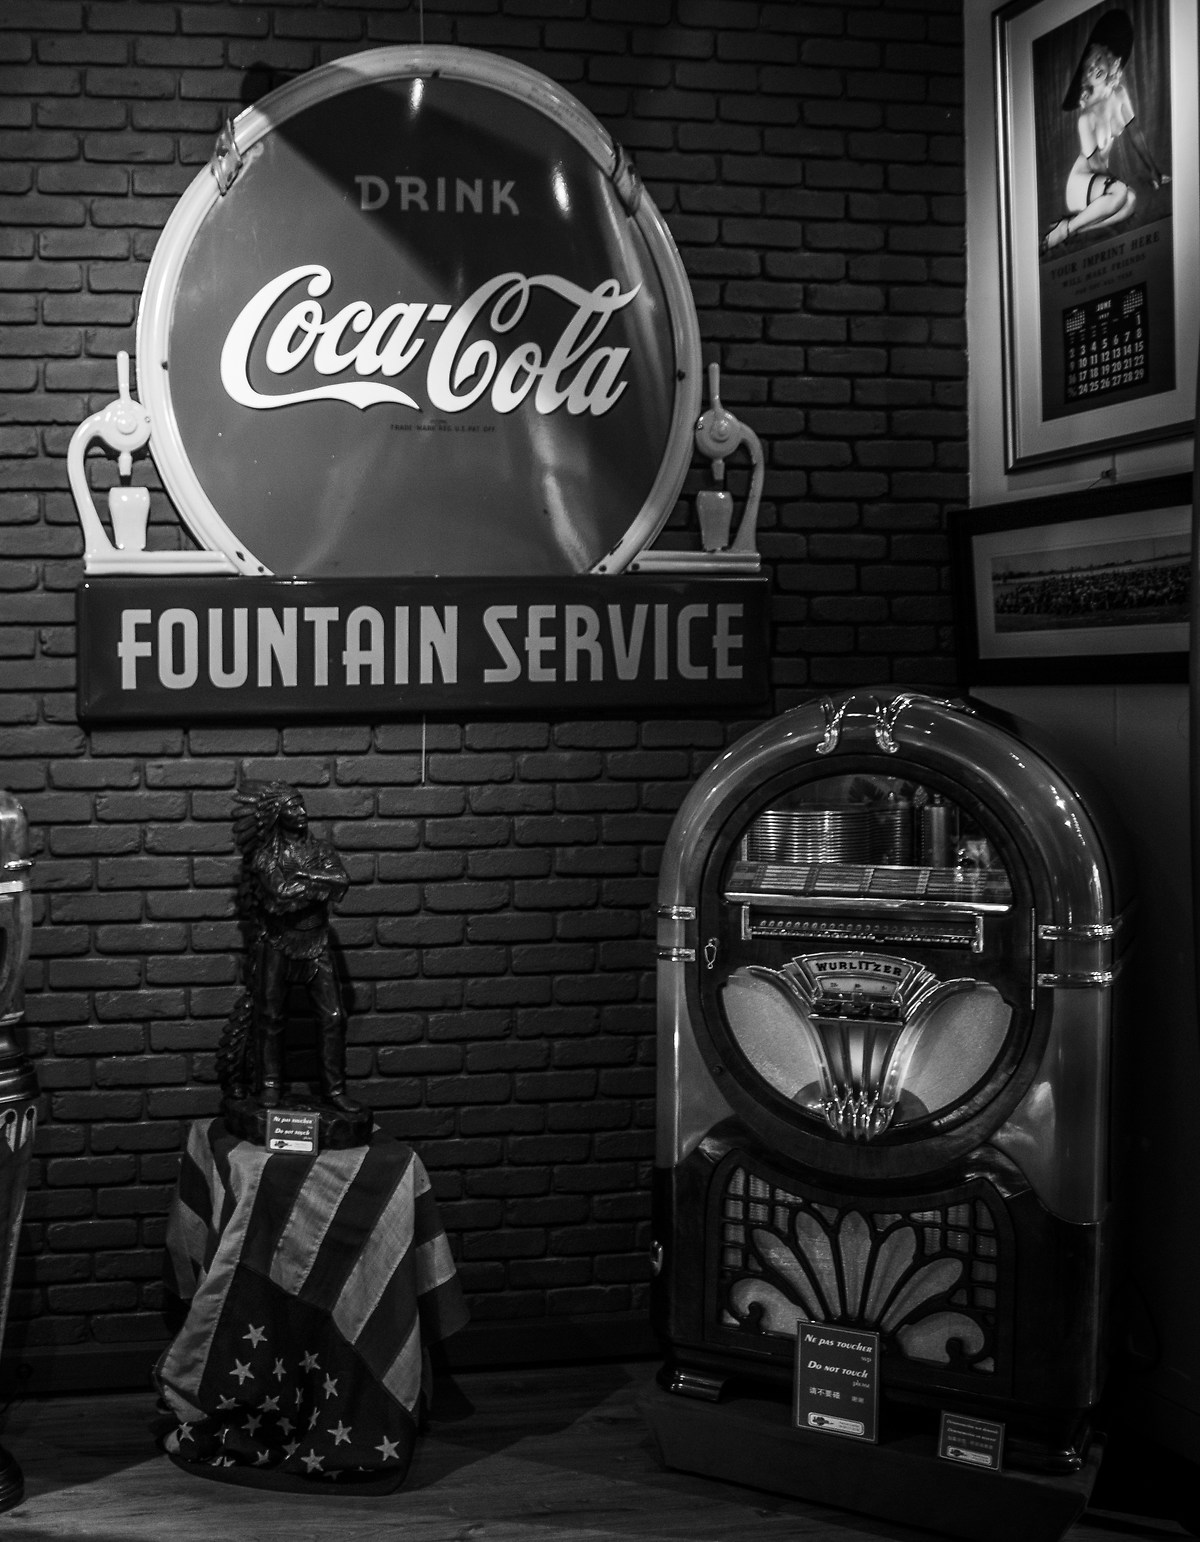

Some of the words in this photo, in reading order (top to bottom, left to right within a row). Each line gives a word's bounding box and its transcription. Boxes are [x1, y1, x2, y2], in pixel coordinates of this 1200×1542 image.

[353, 173, 521, 216] DRINK
[1051, 262, 1078, 280] YOUR
[1083, 243, 1126, 268] IMPRINT
[1130, 231, 1160, 251] HERE
[1096, 299, 1112, 312] JUNE
[1136, 314, 1142, 325] 1
[219, 263, 643, 417] Coca-Cola
[1079, 357, 1088, 368] 10
[1090, 353, 1098, 365] 11
[1101, 350, 1110, 362] 12
[1112, 347, 1121, 359] 13
[1123, 344, 1132, 356] 14
[1134, 340, 1144, 352] 15
[1080, 344, 1086, 356] 3
[1091, 341, 1097, 351] 4
[1101, 337, 1108, 349] 5
[1112, 334, 1119, 346] 6
[1124, 331, 1131, 343] 7
[1136, 327, 1142, 339] 8
[1078, 382, 1088, 395] 24
[1089, 380, 1099, 393] 25
[1100, 377, 1110, 389] 26
[1112, 374, 1121, 386] 27
[1123, 371, 1133, 383] 28
[1134, 368, 1144, 380] 29
[1079, 370, 1087, 382] 17
[1090, 367, 1099, 379] 18
[1101, 364, 1110, 375] 19
[1112, 360, 1122, 373] 20
[1123, 357, 1132, 370] 21
[1134, 354, 1144, 367] 22
[116, 605, 459, 691] FOUNTAIN
[482, 602, 745, 684] SERVICE
[815, 960, 903, 976] WURLITZER
